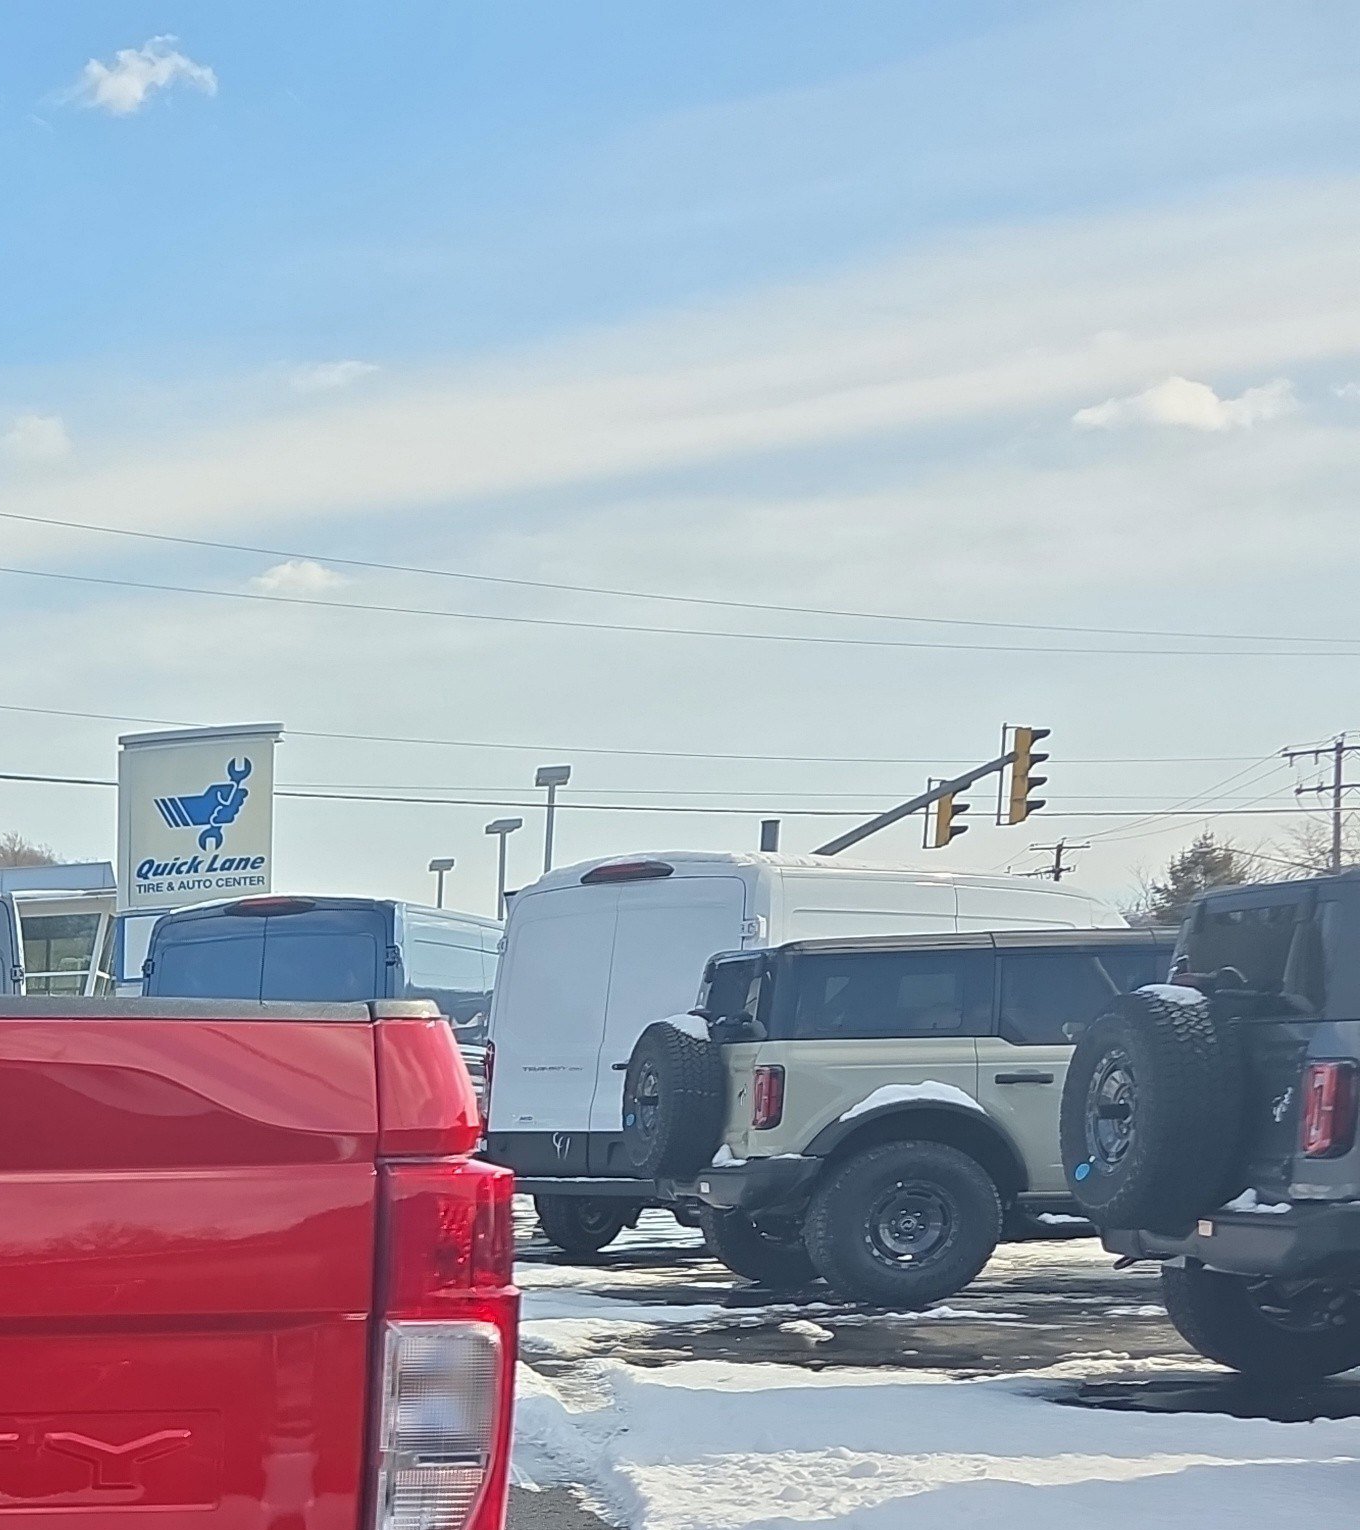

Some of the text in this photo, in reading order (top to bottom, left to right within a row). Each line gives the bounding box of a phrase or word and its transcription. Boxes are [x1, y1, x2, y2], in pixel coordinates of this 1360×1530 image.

[136, 853, 266, 880] Quick Lane
[136, 875, 266, 894] TIRE & AUTO CENTER
